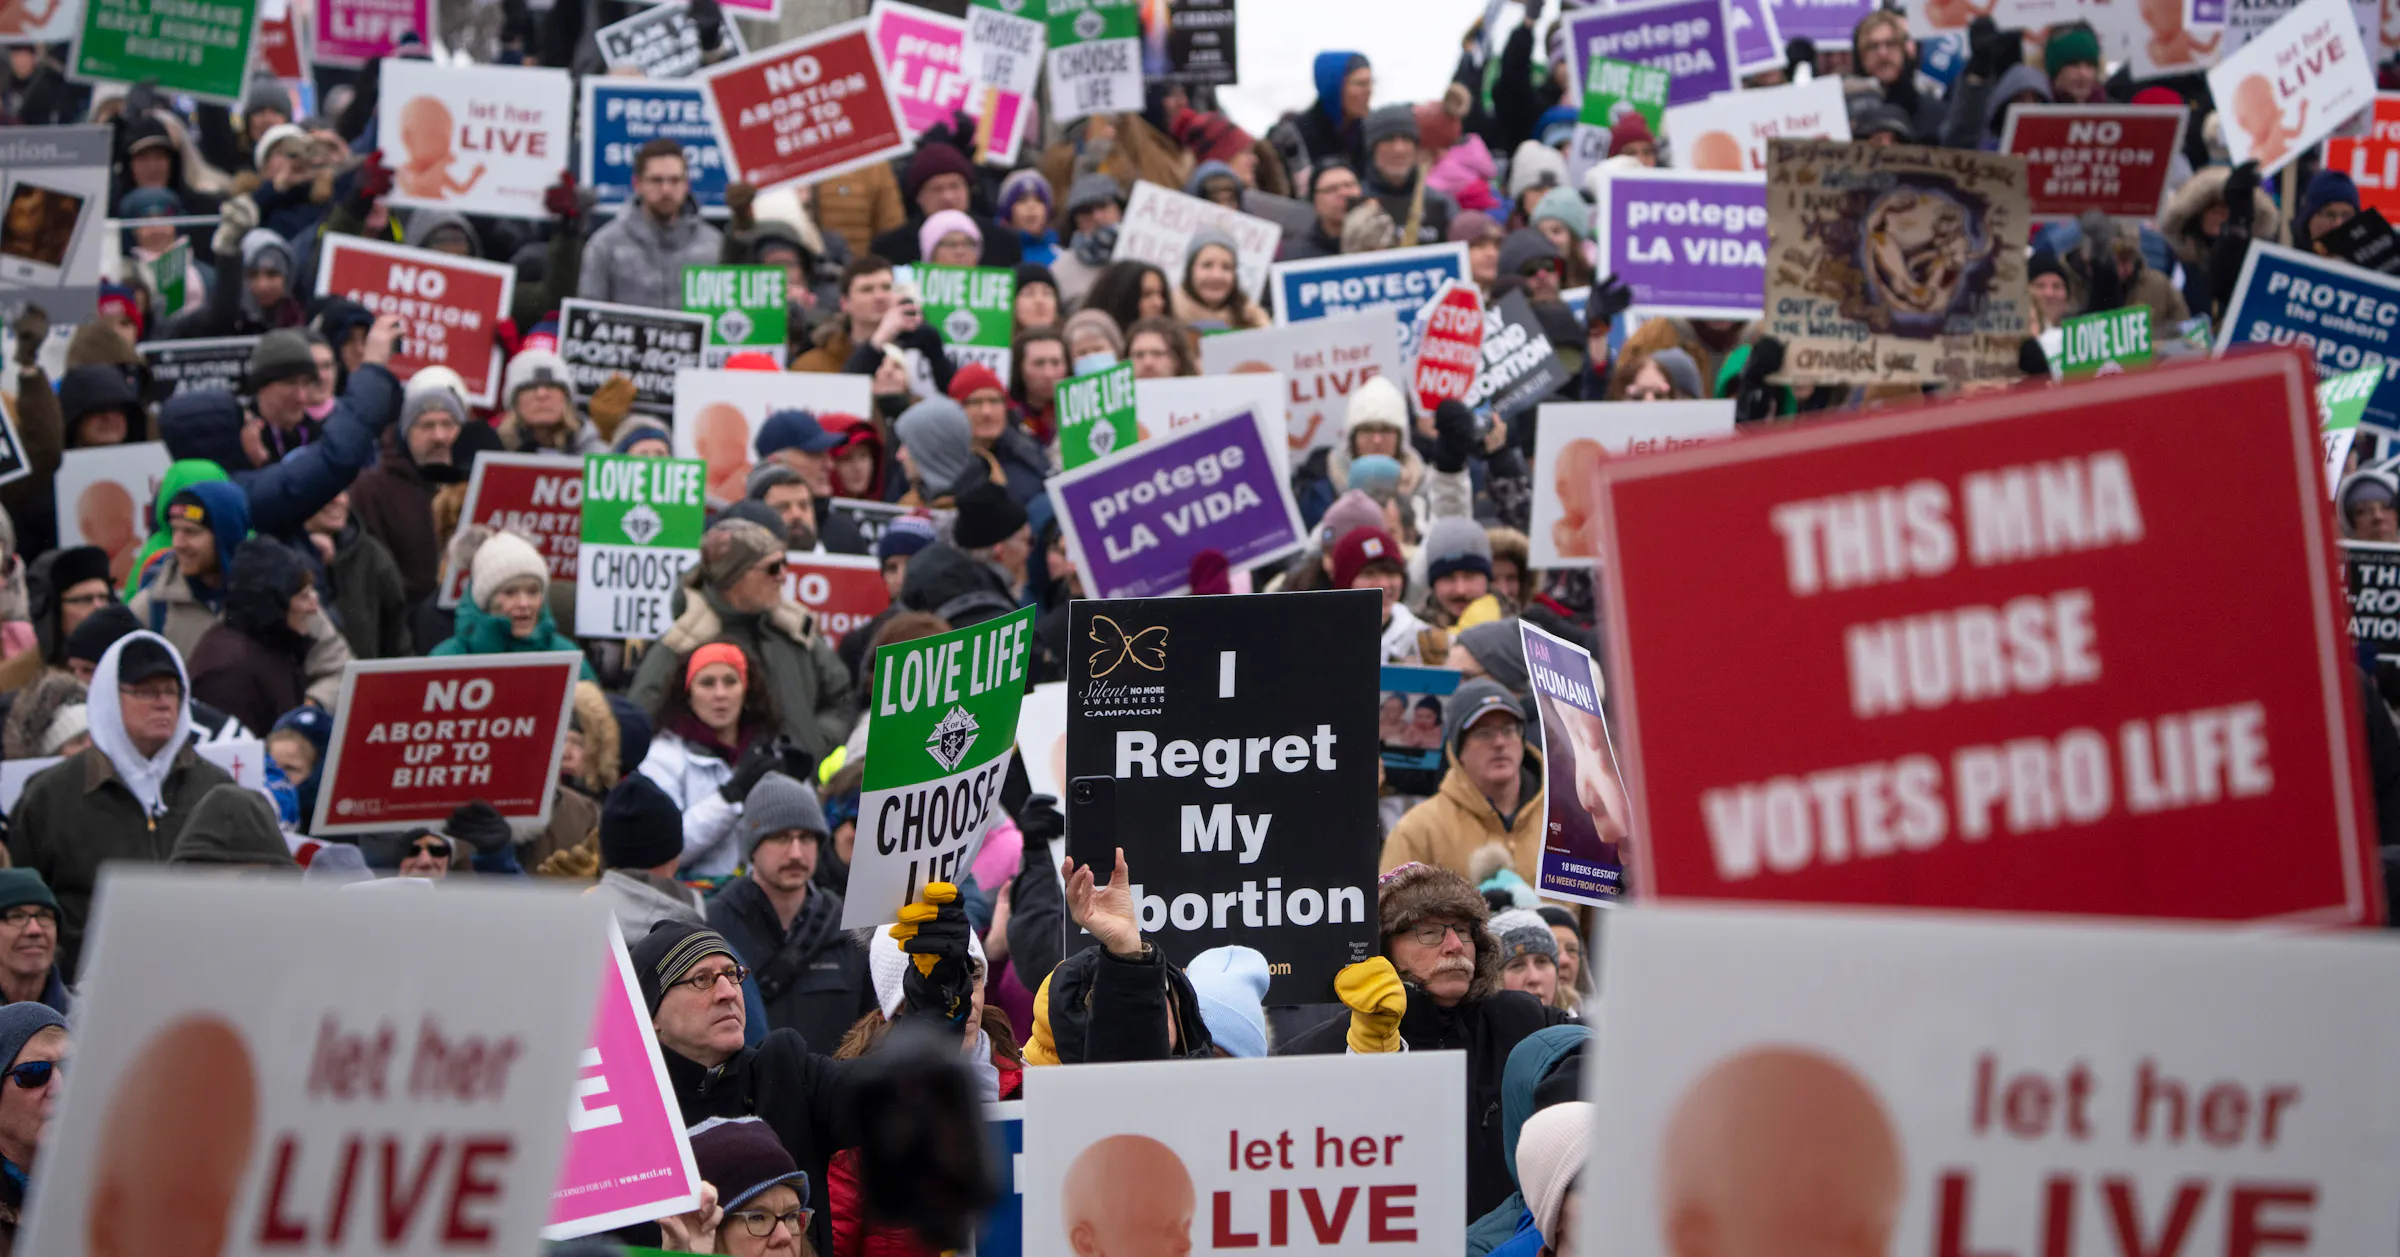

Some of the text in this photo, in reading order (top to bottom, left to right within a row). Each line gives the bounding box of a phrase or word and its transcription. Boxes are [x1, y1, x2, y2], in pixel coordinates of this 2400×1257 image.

[96, 11, 153, 35] HAVE
[160, 19, 240, 50] HUMAN
[1588, 17, 1712, 56] protege
[2274, 42, 2300, 68] let
[2302, 19, 2331, 48] her
[124, 36, 205, 67] RIGHTS
[1056, 42, 1131, 82] CHOOSE
[2278, 34, 2347, 98] LIVE
[763, 54, 822, 96] NO
[888, 59, 982, 117] LIFE
[1589, 57, 1670, 107] LOVE LIFE
[468, 99, 544, 124] let her
[738, 71, 867, 130] ABORTION
[774, 100, 842, 136] UP TO
[460, 124, 549, 158] LIVE
[774, 116, 854, 157] BIRTH
[1752, 111, 1823, 139] let her
[2066, 120, 2123, 146] NO
[2023, 148, 2155, 166] ABORTION
[2051, 164, 2121, 181] UP TO
[2043, 180, 2121, 197] BIRTH
[1627, 197, 1767, 234] protege
[1627, 236, 1767, 269] LA VIDA
[388, 263, 447, 299] NO
[685, 268, 784, 309] LOVE LIFE
[914, 266, 1013, 311] LOVE LIFE
[1299, 267, 1447, 306] PROTECT
[2266, 270, 2400, 328] PROTEC
[415, 321, 447, 343] TO
[573, 319, 584, 338] I
[594, 321, 637, 343] AM
[643, 328, 696, 351] THE
[1432, 304, 1482, 334] STOP
[2065, 316, 2112, 365] LOVE
[2112, 311, 2149, 357] LIFE
[2285, 302, 2390, 344] the unborn
[1293, 343, 1373, 370] let her
[1058, 366, 1135, 428] LOVE LIFE
[1419, 366, 1470, 398] NOW
[531, 476, 583, 507] NO
[588, 459, 702, 505] LOVE LIFE
[1089, 445, 1246, 530] protege
[486, 509, 581, 535] ABORTI
[1103, 523, 1159, 563] LA
[1161, 482, 1262, 537] VIDA
[1770, 448, 2146, 598] THIS MNA
[551, 535, 580, 553] TO
[613, 596, 662, 635] LIFE
[879, 618, 1028, 718] LOVE LIFE
[1527, 637, 1551, 663] I AM
[1843, 586, 2103, 721] NURSE
[1079, 680, 1165, 699] Silent NO MORE
[1219, 650, 1237, 699] I
[1532, 663, 1594, 712] HUMAN!
[422, 677, 495, 713] NO
[1083, 696, 1165, 706] AWARENESS
[1084, 708, 1162, 717] CAMPAIGN
[365, 716, 537, 745] ABORTION
[942, 717, 969, 733] K OF C
[402, 740, 491, 766] UP TO
[1115, 724, 1337, 789] Regret
[390, 763, 492, 789] BIRTH
[1700, 699, 2275, 883] VOTES PRO LIFE
[876, 762, 1001, 857] CHOOSE
[1181, 803, 1273, 864] My
[1544, 874, 1557, 886] (16
[1557, 876, 1577, 889] WEEKS
[1577, 879, 1595, 892] FROM
[1561, 862, 1570, 872] 18
[1570, 863, 1592, 876] WEEKS
[1080, 877, 1365, 935] bortion
[1348, 941, 1369, 949] Register
[307, 1008, 398, 1101] let
[408, 1013, 524, 1102] her
[1969, 1048, 2303, 1150] let her
[1229, 1126, 1405, 1171] let her
[256, 1130, 516, 1249] LIVE
[586, 1182, 600, 1193] FOR
[600, 1179, 613, 1190] LIFE
[619, 1166, 673, 1185] www.mccl.org
[1211, 1184, 1419, 1249] LIVE
[1931, 1167, 2319, 1257] LIVE
